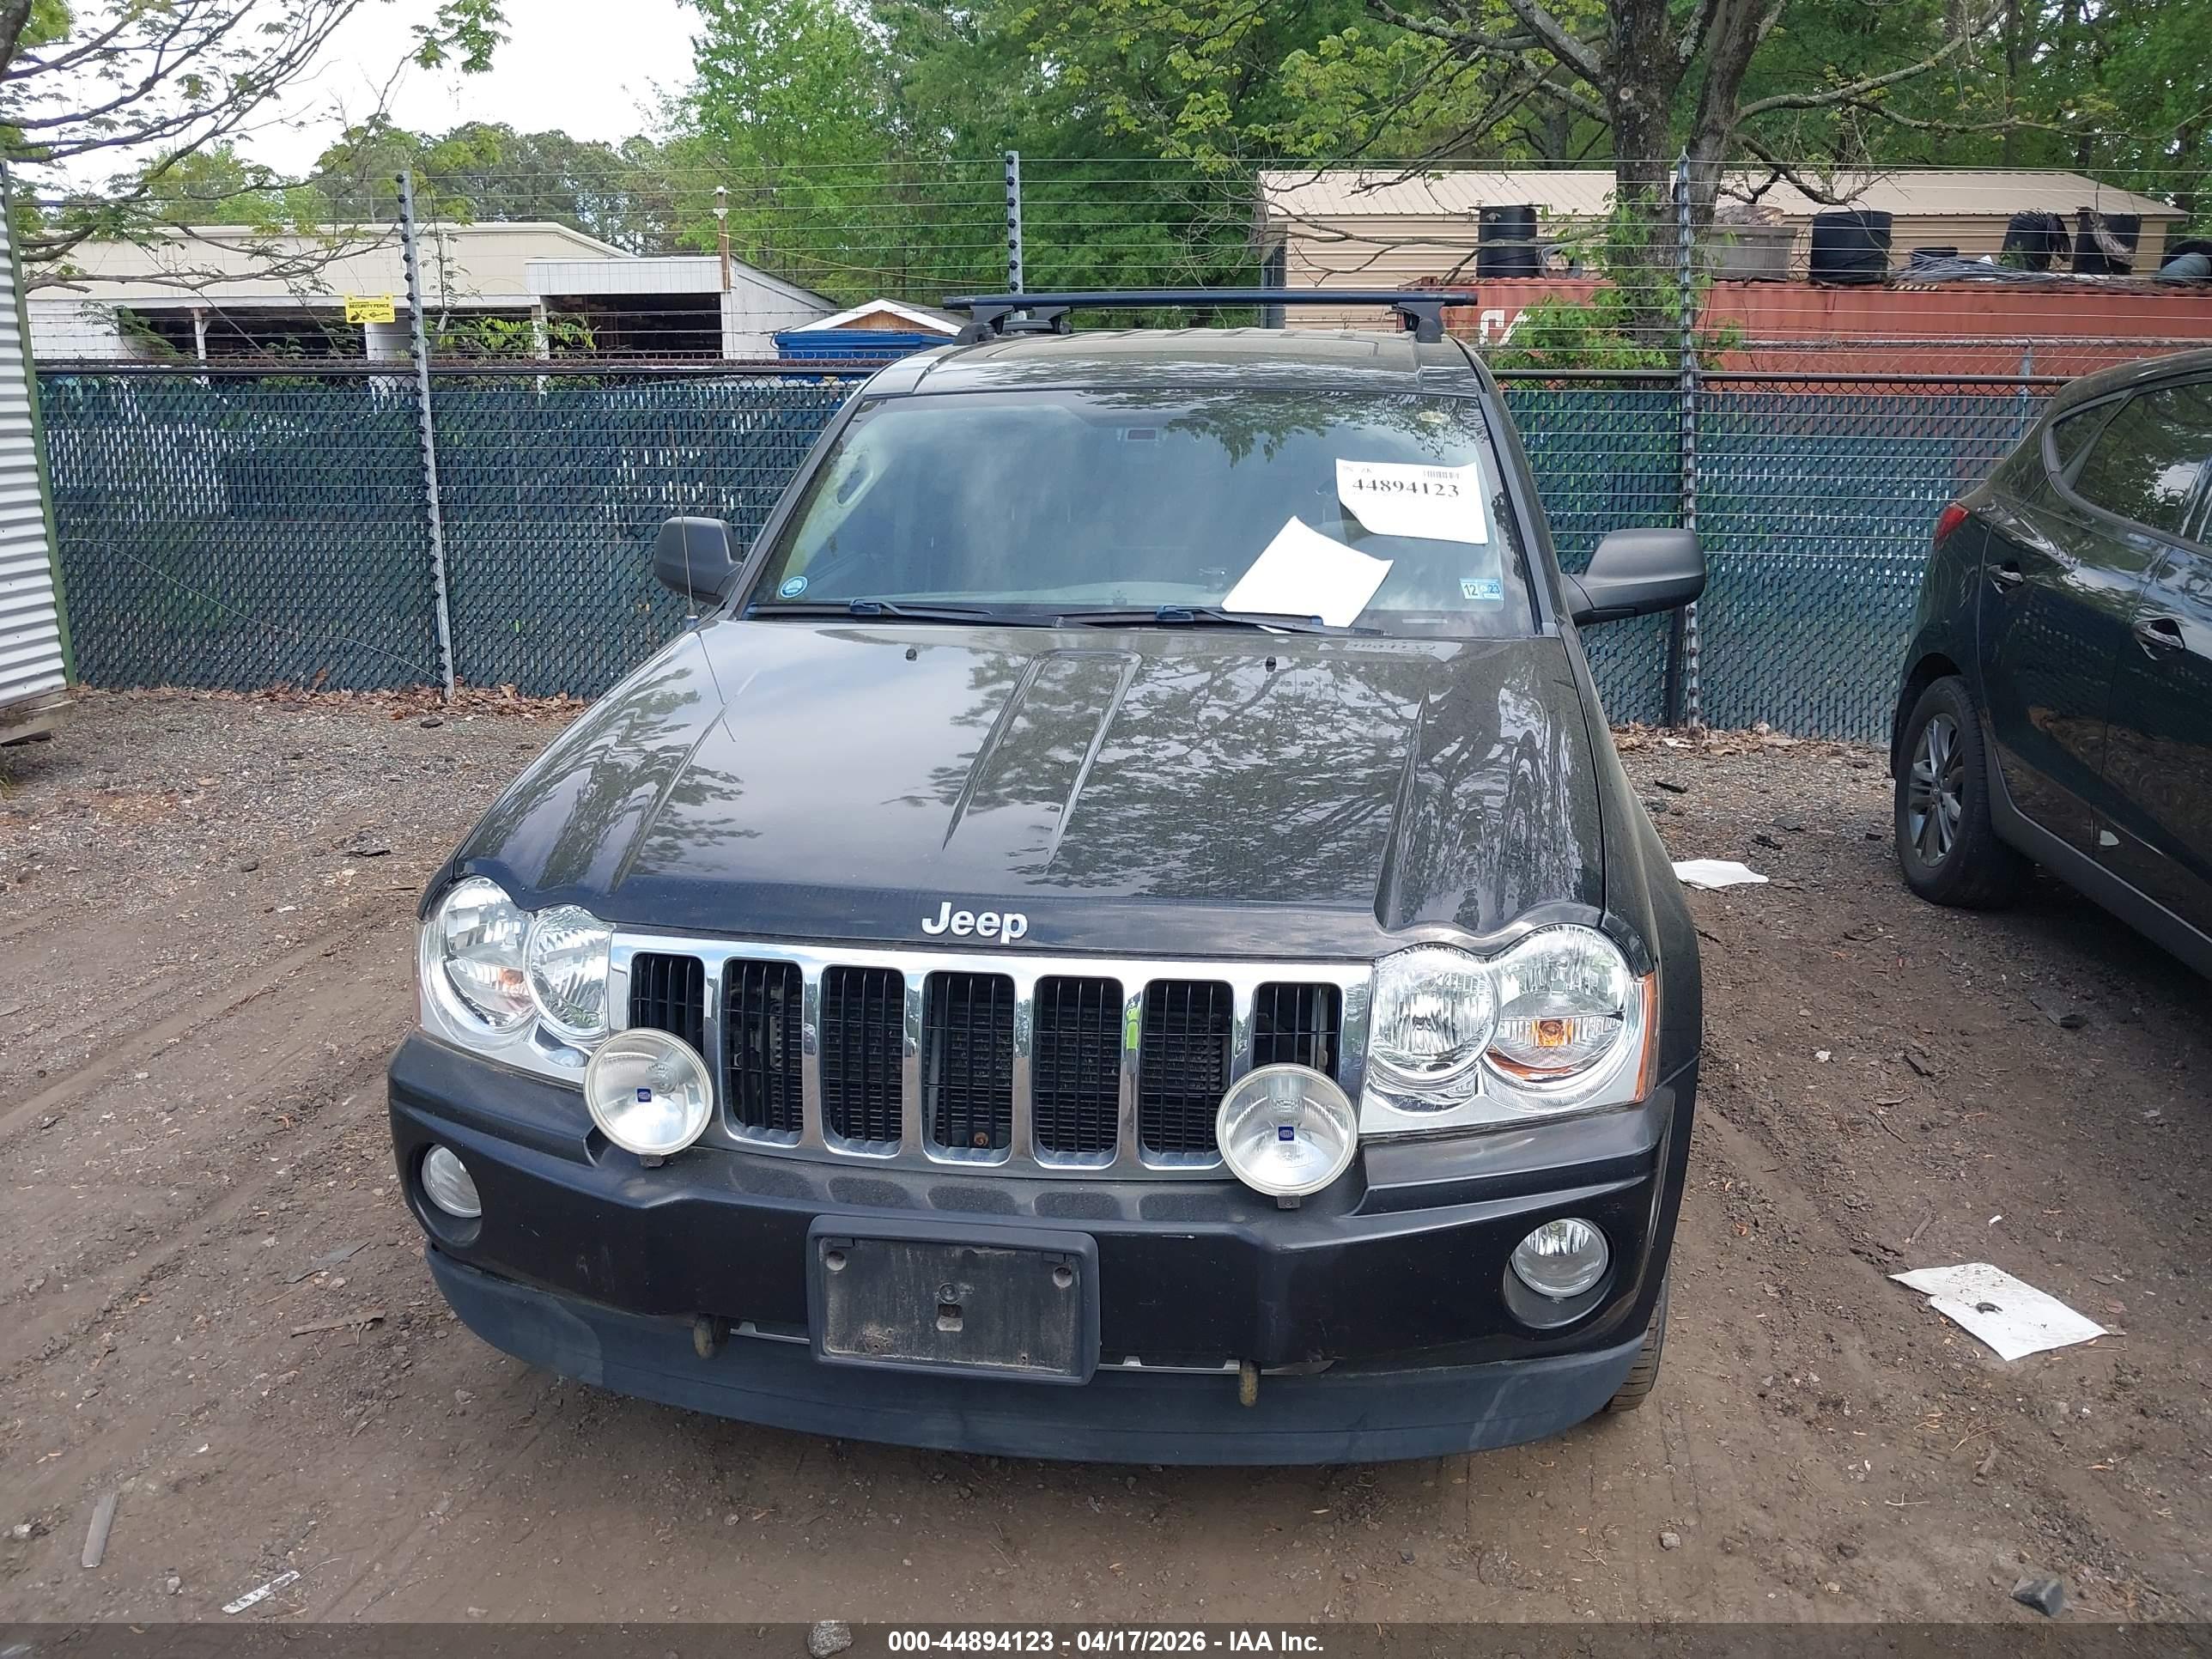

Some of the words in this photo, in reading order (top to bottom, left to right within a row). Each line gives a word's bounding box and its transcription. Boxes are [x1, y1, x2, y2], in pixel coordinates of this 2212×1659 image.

[1352, 478, 1460, 497] 44894123
[1464, 584, 1478, 596] 12
[921, 902, 1028, 945] Jeep
